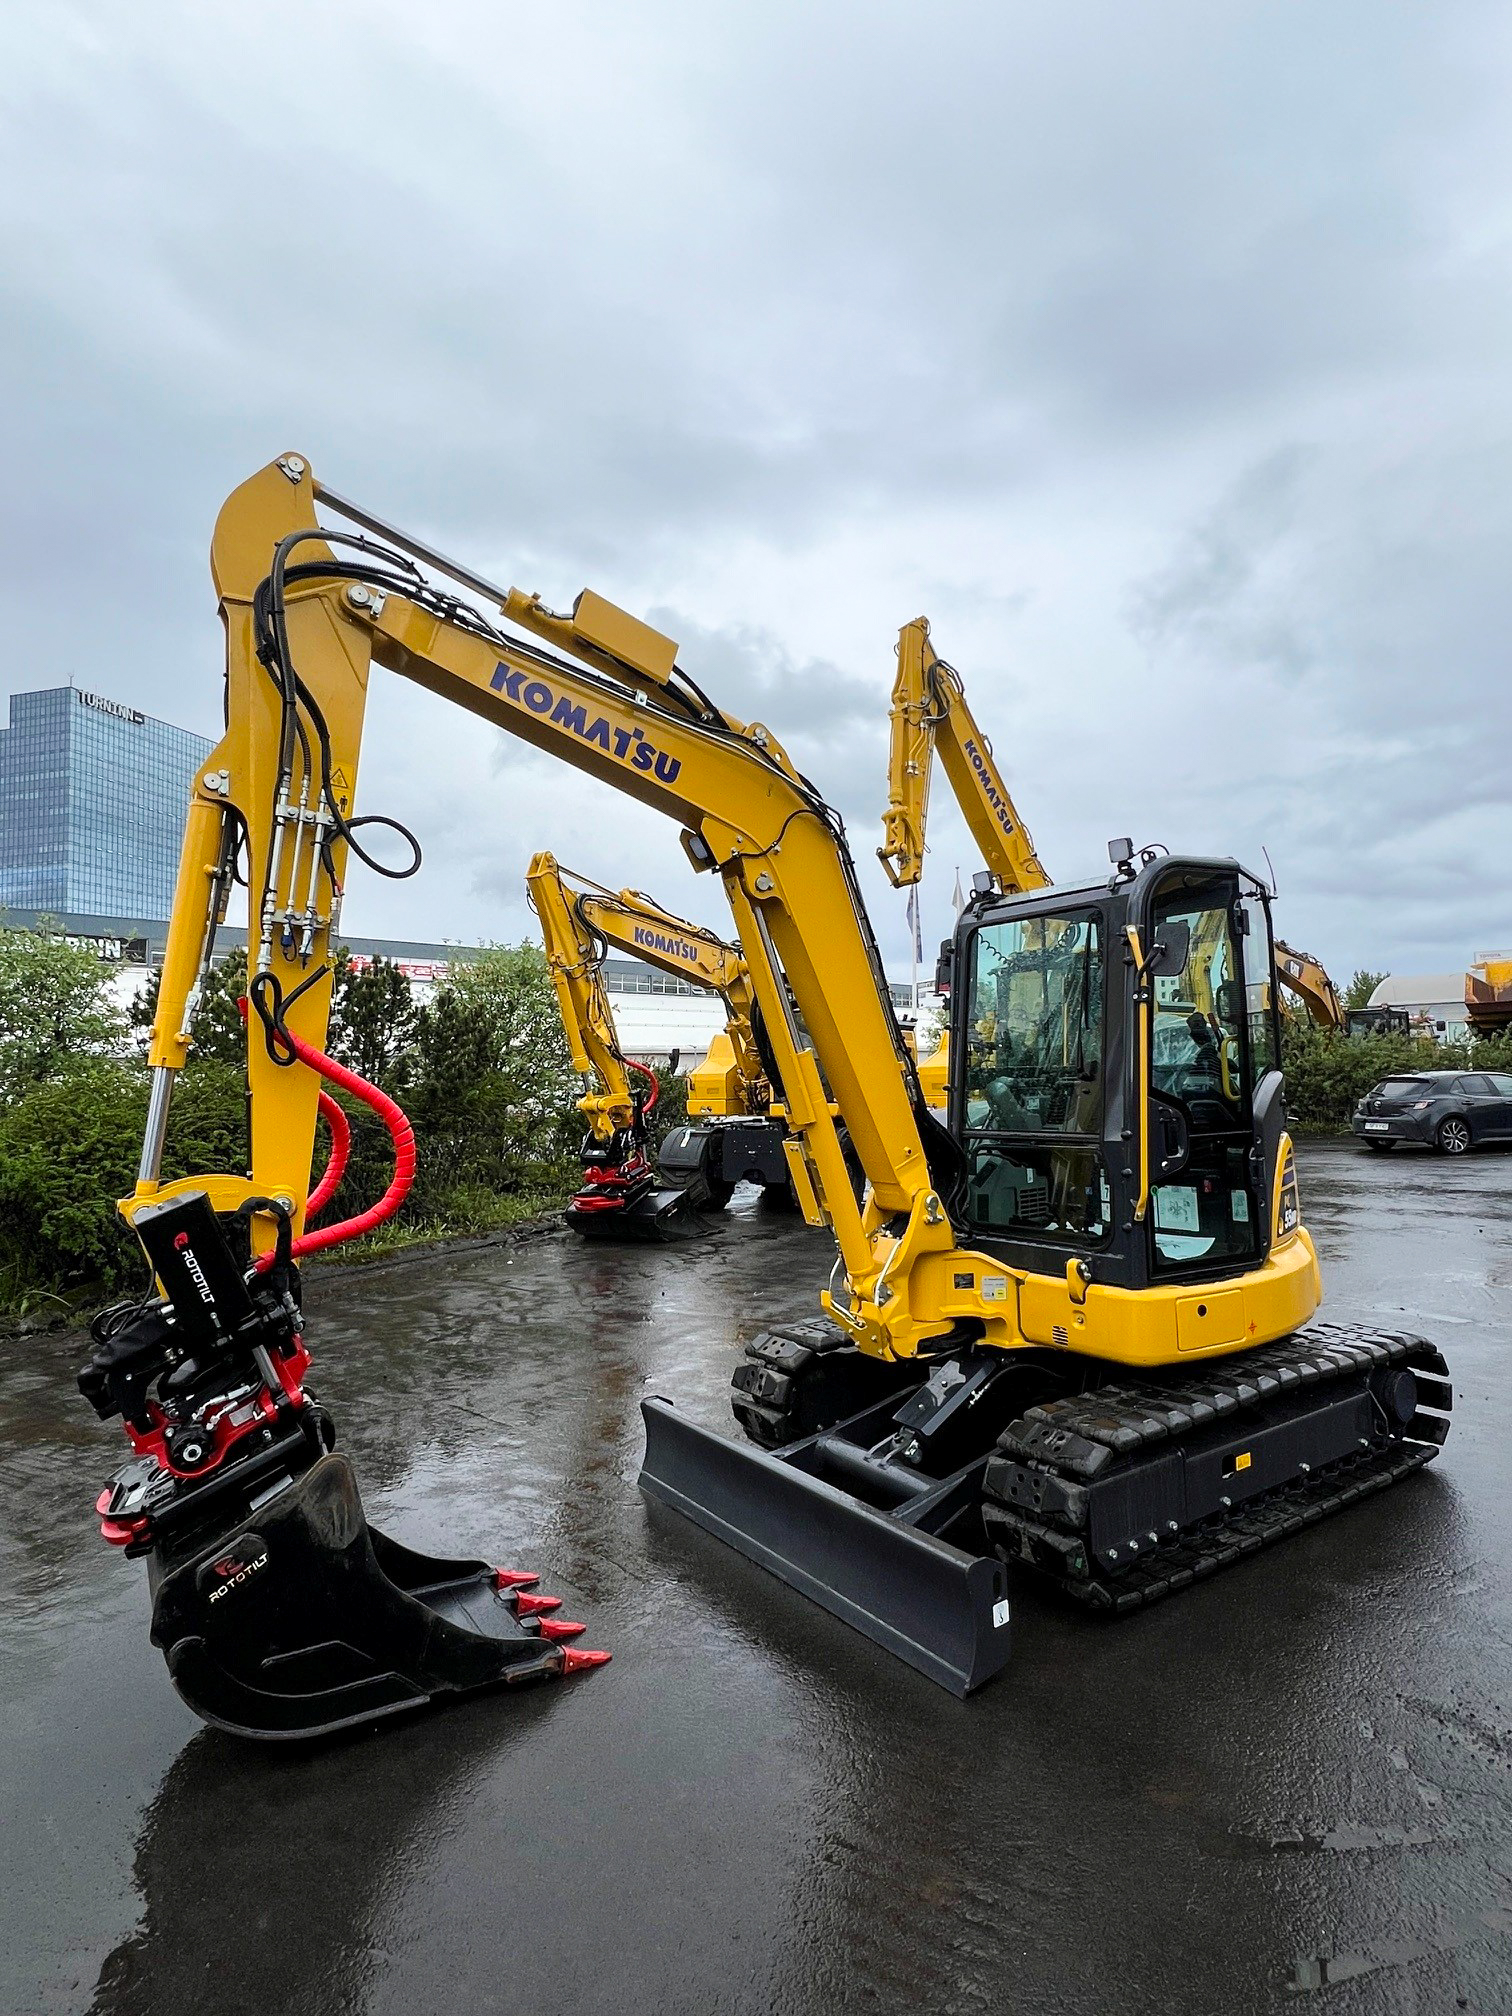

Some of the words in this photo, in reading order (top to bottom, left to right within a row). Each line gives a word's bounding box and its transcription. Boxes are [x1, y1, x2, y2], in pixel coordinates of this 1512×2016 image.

[78, 690, 134, 722] TURNINN
[489, 661, 682, 784] KOMATSU
[964, 739, 1014, 834] KOMATSU
[634, 926, 698, 962] KOMATSU
[181, 1249, 215, 1303] ROTOTILT
[208, 1552, 268, 1604] ROTOTILT
